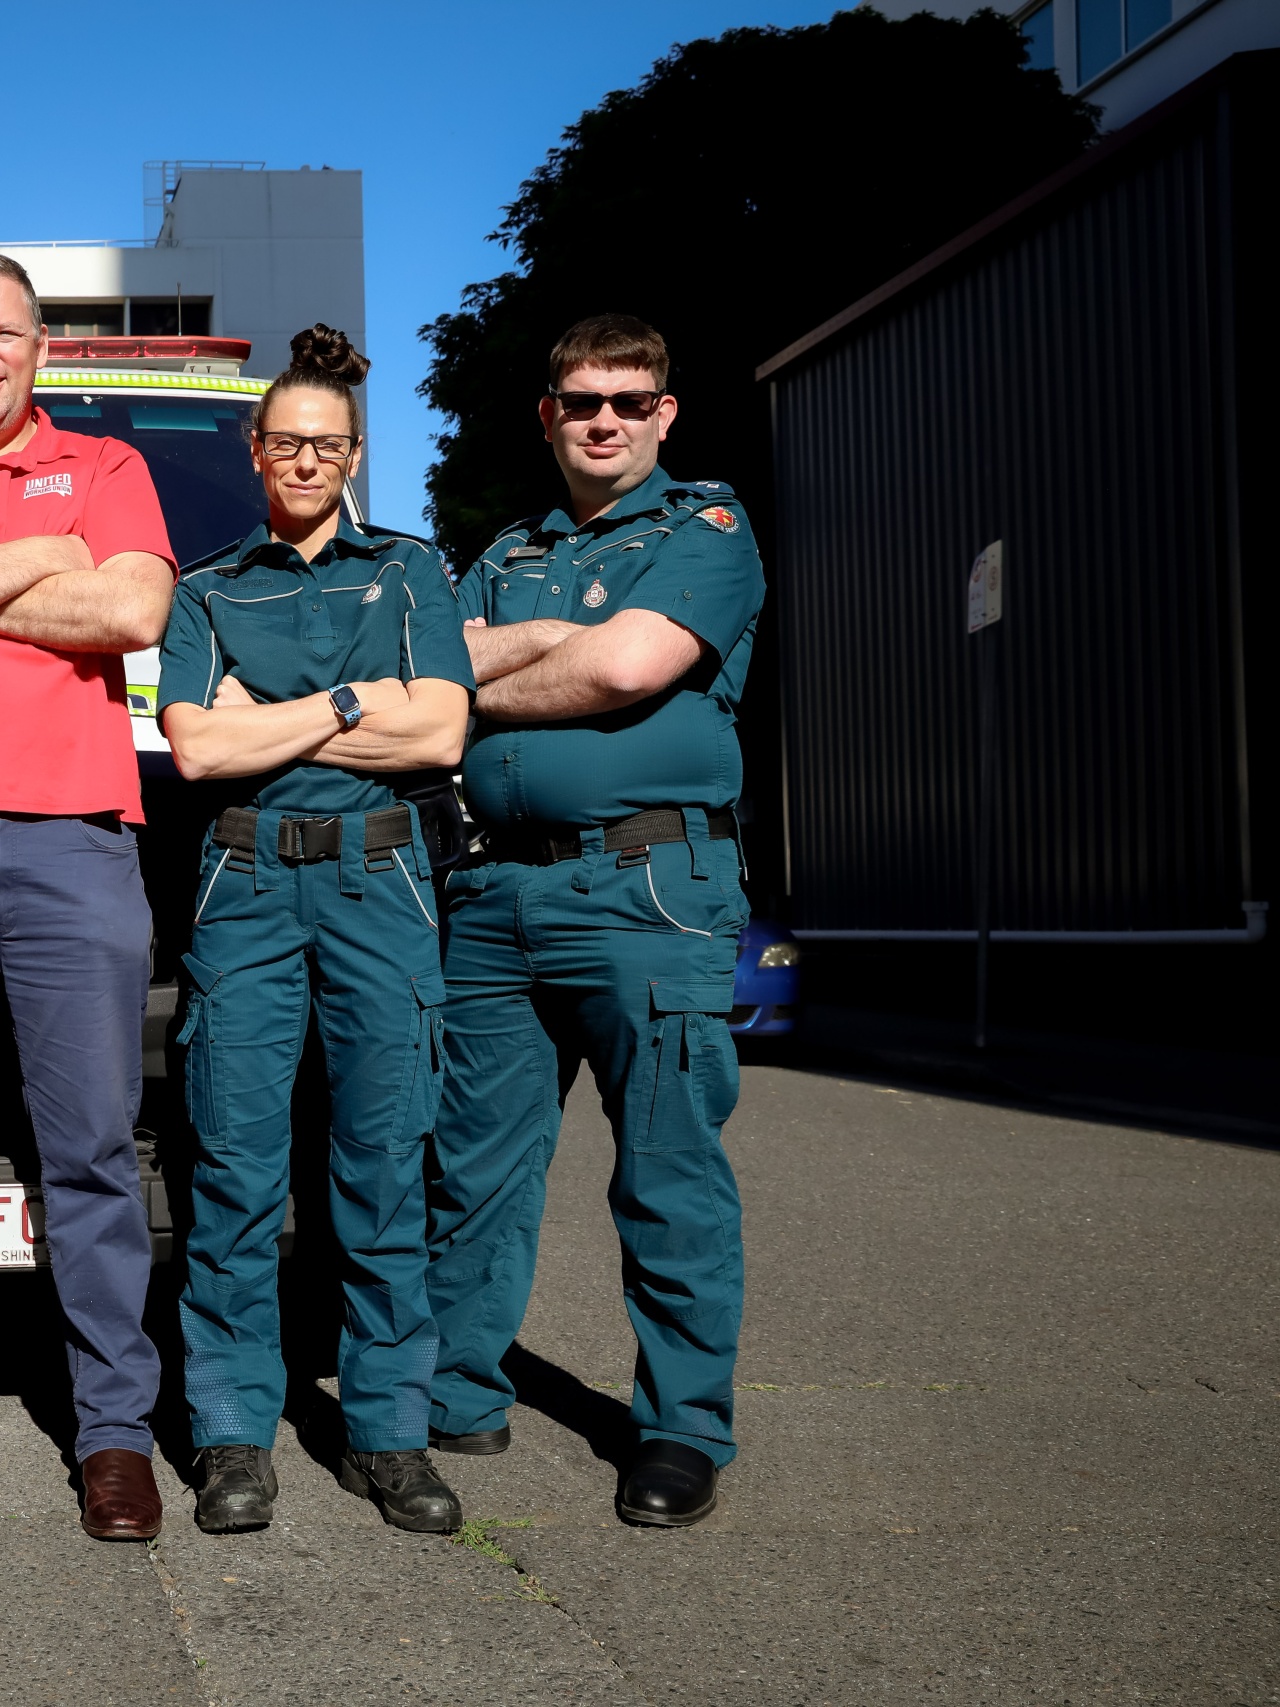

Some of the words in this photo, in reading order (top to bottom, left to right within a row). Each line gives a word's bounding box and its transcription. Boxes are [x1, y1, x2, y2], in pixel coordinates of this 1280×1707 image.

[25, 473, 72, 491] UNITED
[25, 487, 52, 496] WORKERS
[53, 485, 71, 493] UNION
